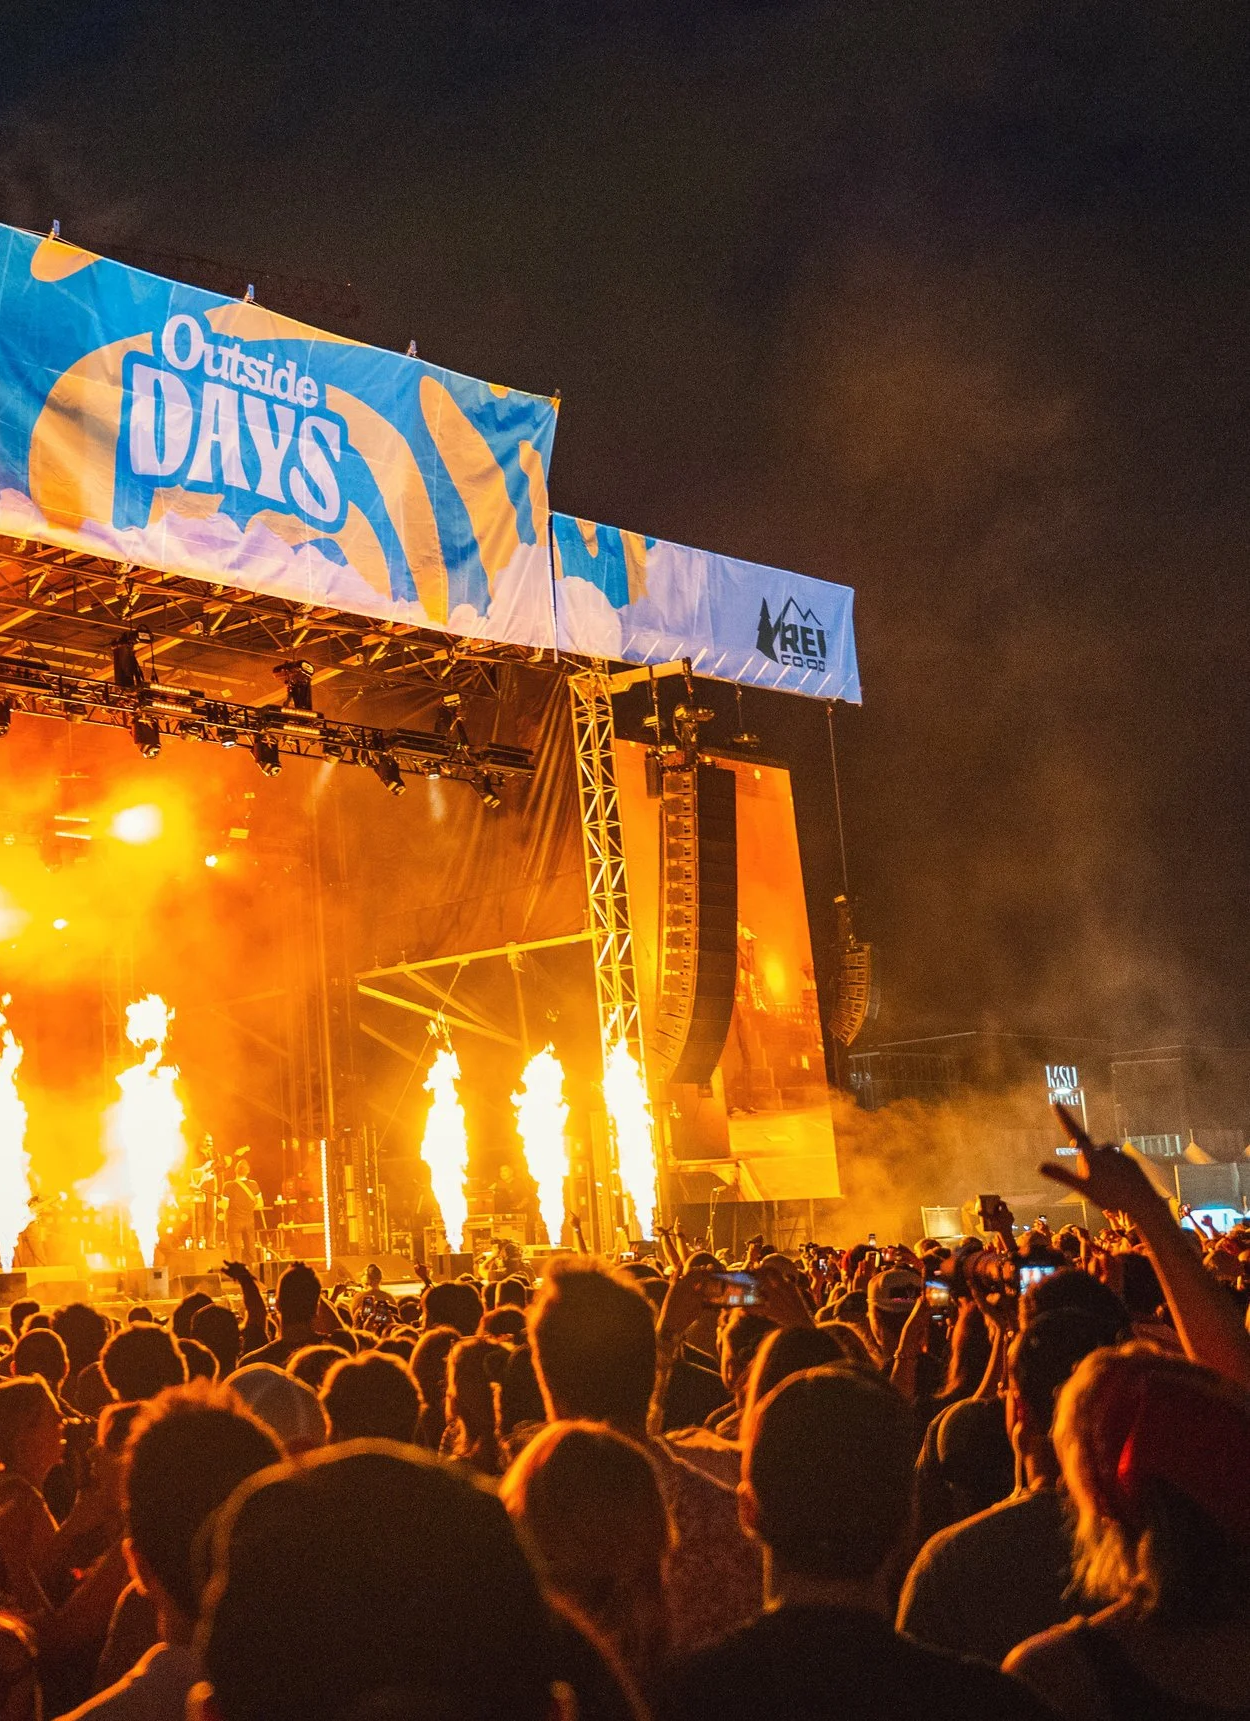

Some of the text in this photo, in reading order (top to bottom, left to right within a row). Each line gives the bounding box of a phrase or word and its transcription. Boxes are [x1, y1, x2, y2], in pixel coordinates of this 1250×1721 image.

[161, 314, 319, 409] Outside
[129, 363, 341, 523] DAYS
[779, 621, 827, 659] REI
